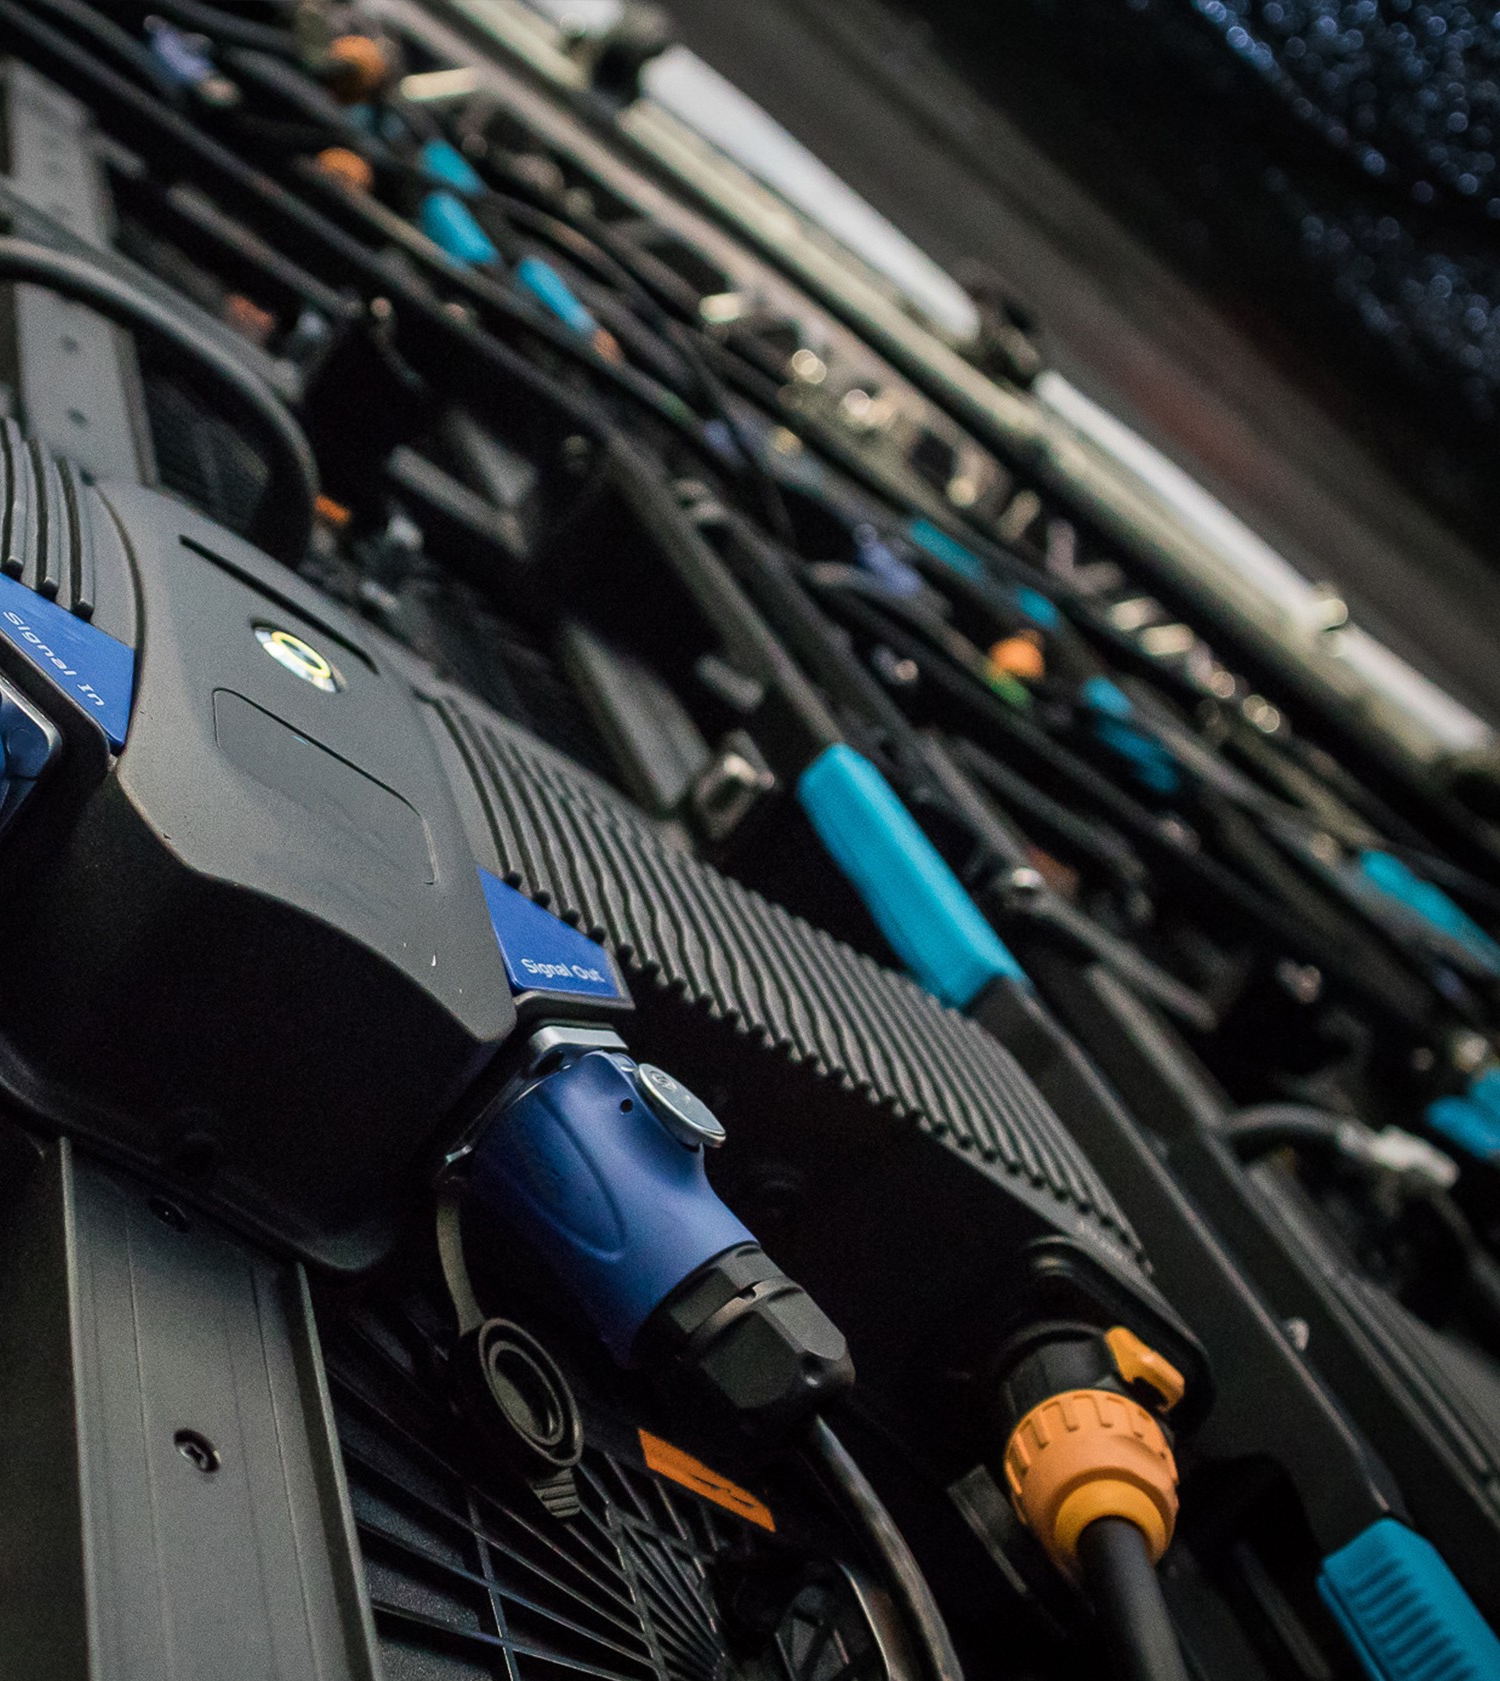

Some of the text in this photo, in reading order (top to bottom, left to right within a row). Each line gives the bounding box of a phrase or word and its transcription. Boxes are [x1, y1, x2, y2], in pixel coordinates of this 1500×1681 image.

[3, 611, 105, 706] Signal In
[520, 958, 605, 983] Signal Out
